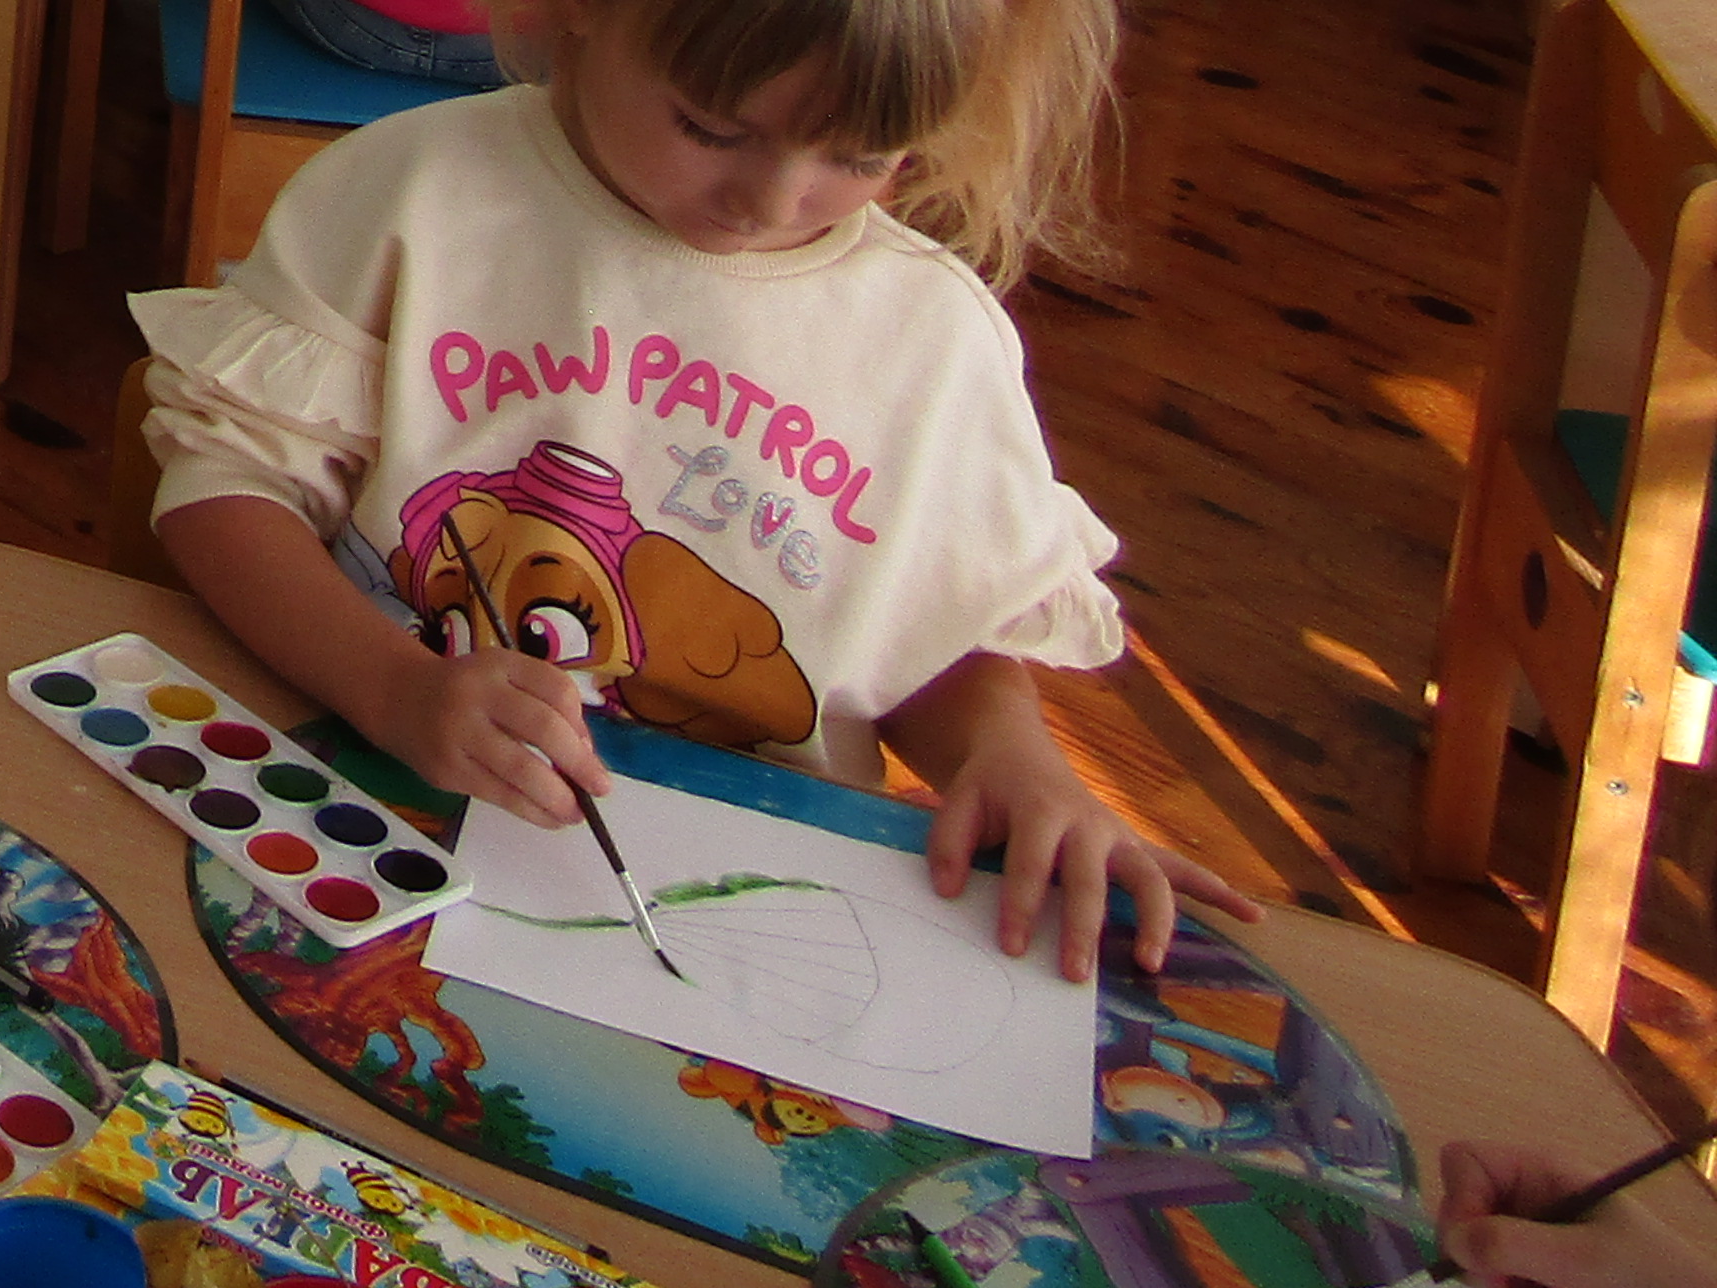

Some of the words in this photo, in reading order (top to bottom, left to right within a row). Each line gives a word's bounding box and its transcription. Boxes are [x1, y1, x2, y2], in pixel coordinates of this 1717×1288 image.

[429, 325, 612, 423] PAW
[629, 333, 879, 545] PATROL
[659, 441, 823, 589] Love
[289, 1187, 389, 1240] фарби
